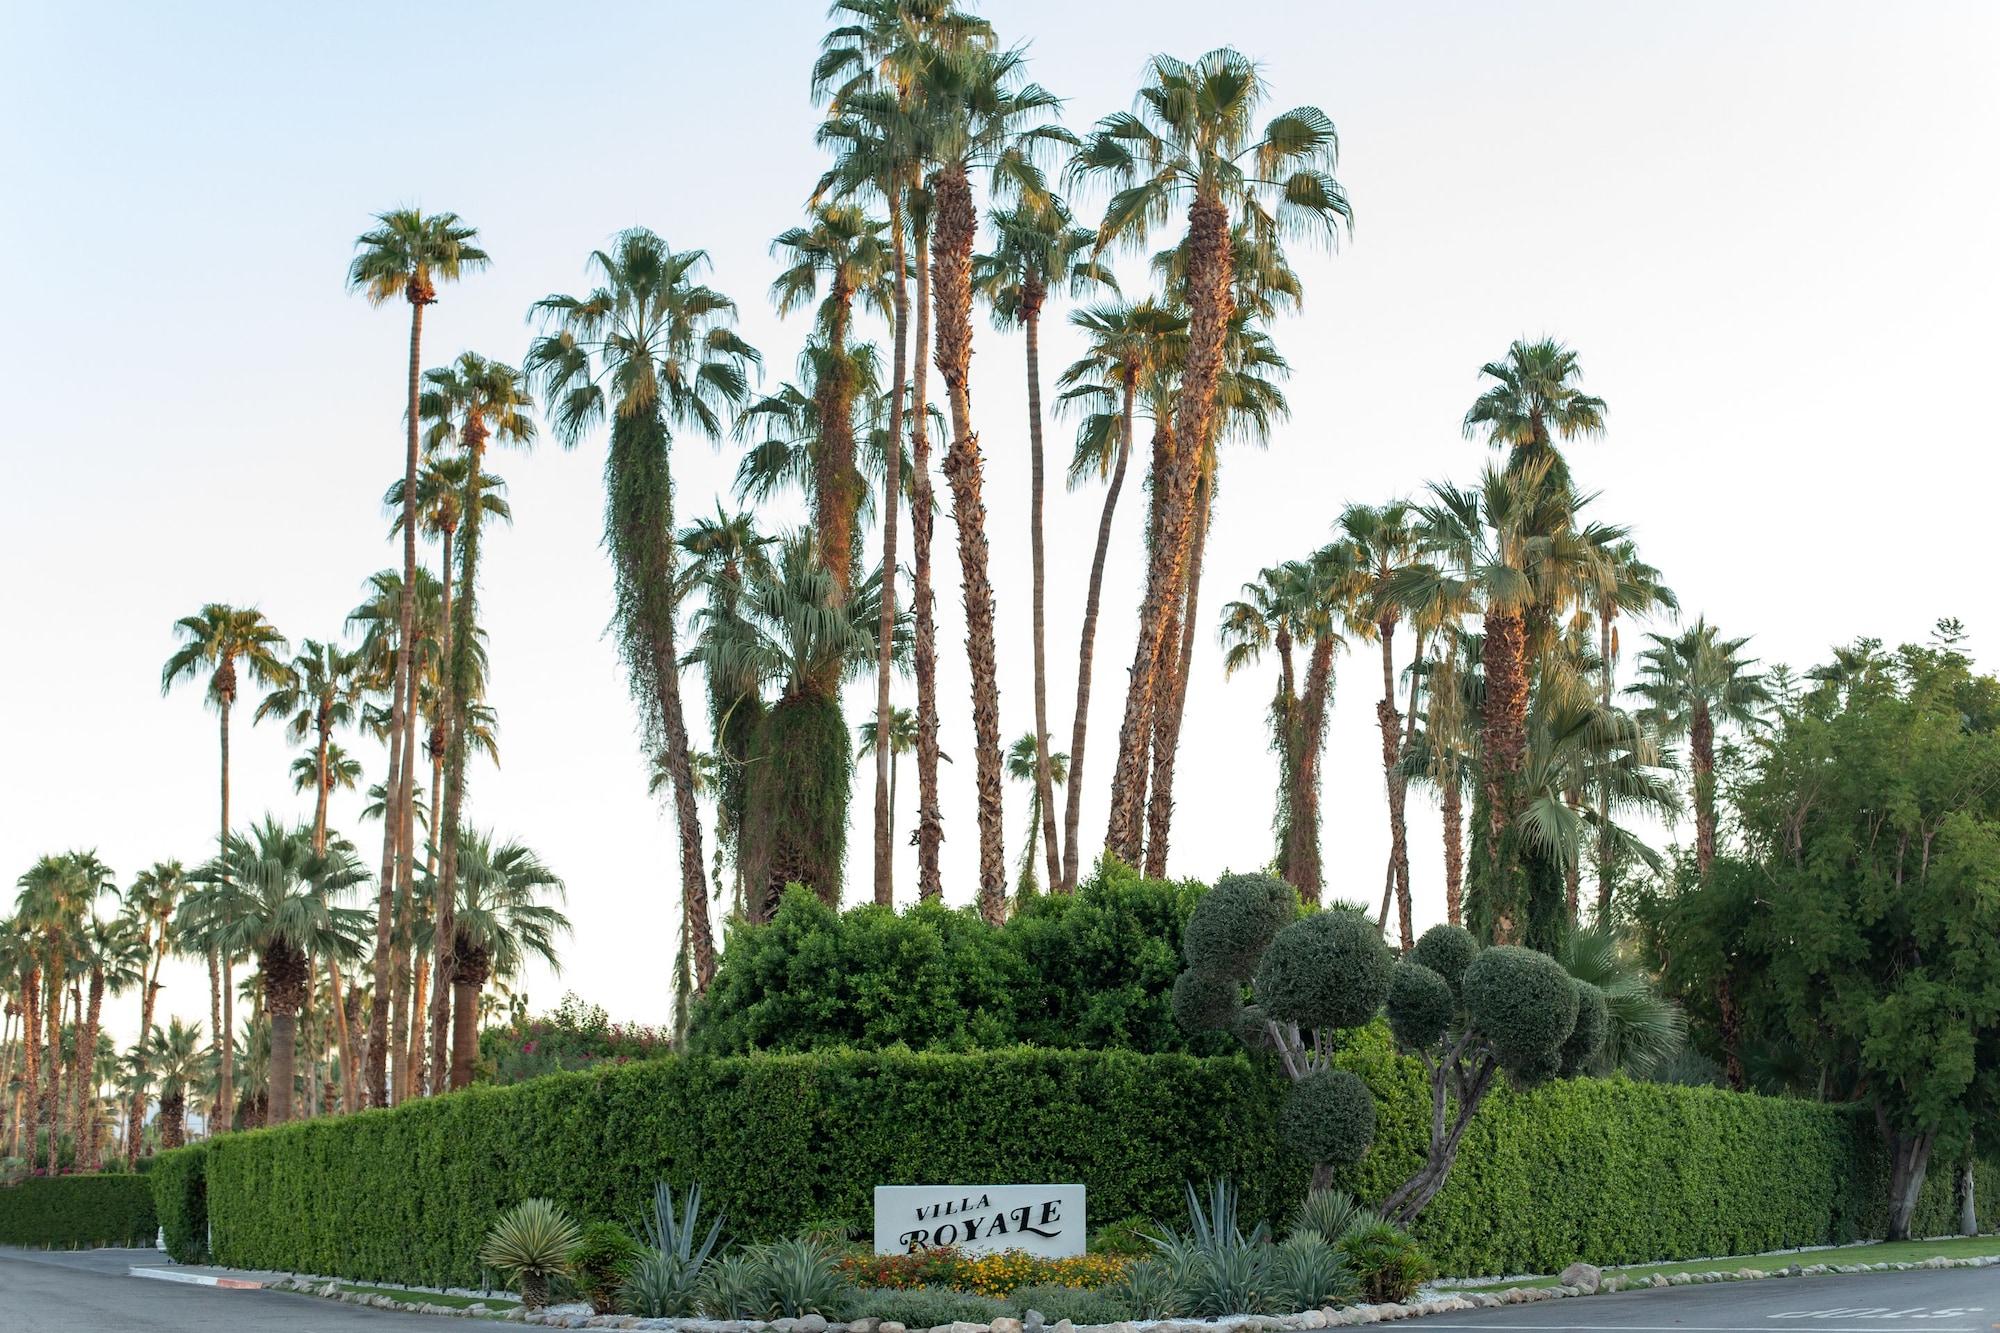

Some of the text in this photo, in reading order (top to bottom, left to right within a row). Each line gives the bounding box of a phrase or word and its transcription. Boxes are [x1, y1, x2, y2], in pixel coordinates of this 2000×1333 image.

[916, 1194, 990, 1221] VILLA
[900, 1199, 1062, 1254] ROYALE
[1766, 1307, 1984, 1318] STOP
